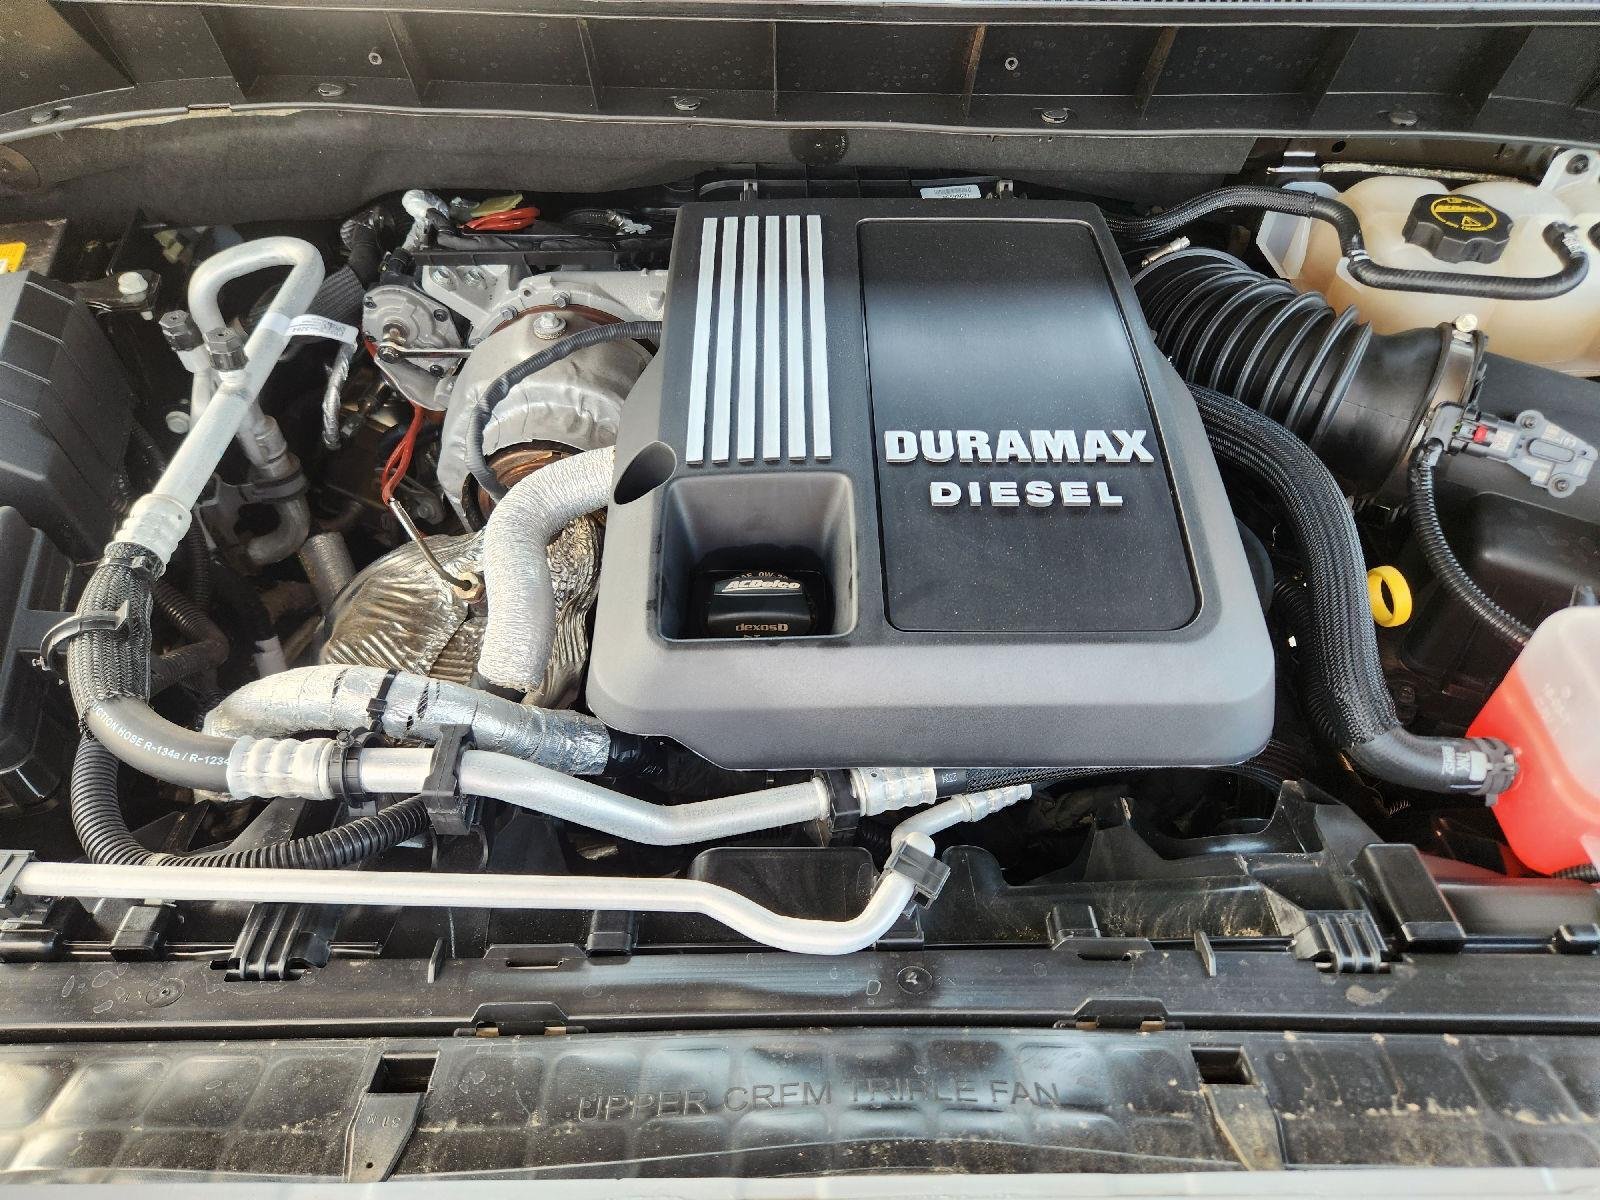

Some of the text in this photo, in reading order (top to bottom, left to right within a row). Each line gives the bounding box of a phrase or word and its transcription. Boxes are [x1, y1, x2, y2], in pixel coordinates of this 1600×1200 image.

[884, 430, 1155, 463] DURAMAX
[930, 481, 1123, 507] DIESEL
[725, 580, 801, 590] ACDelco
[91, 701, 119, 733] UCTION
[117, 726, 145, 747] HOSE
[143, 741, 181, 761] R-134a
[577, 1077, 1062, 1123] UPPER CRFM TRIPLE FAN
